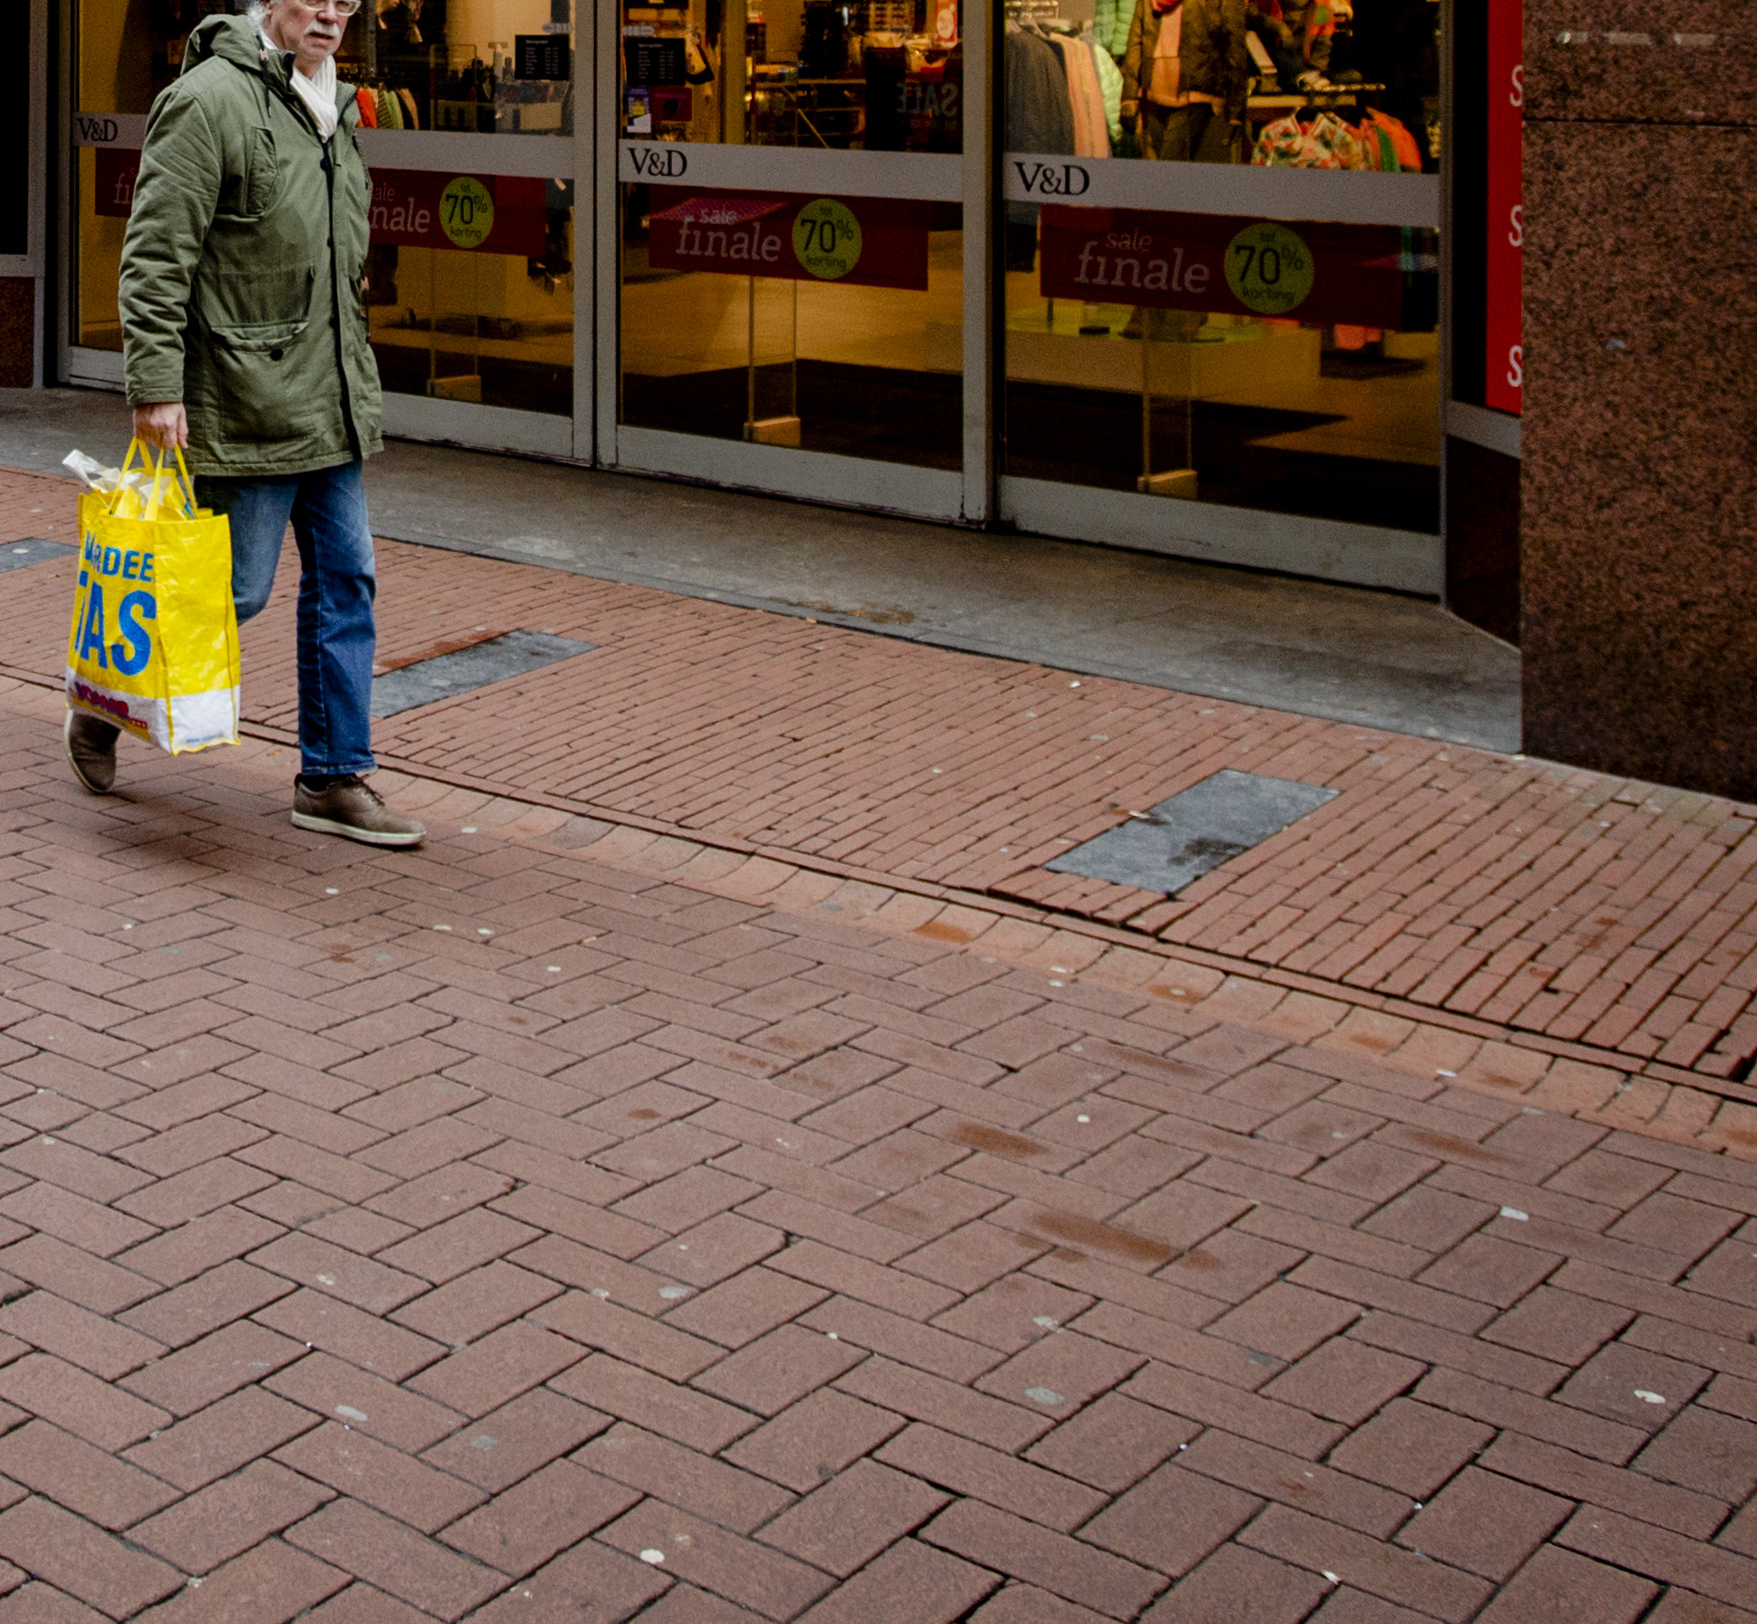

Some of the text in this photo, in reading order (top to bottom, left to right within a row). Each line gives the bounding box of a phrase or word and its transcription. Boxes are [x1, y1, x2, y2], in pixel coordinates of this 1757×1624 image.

[76, 117, 118, 143] V&D
[627, 147, 687, 177] V&D
[374, 182, 396, 202] ale
[1014, 161, 1090, 196] V&D
[370, 197, 431, 233] nale
[445, 194, 489, 225] 70%
[699, 204, 739, 225] sale
[675, 215, 782, 261] finale
[800, 219, 854, 253] 70%
[1105, 227, 1152, 252] sale
[806, 254, 847, 272] korting
[1074, 240, 1210, 294] finale
[1235, 244, 1305, 285] 70%
